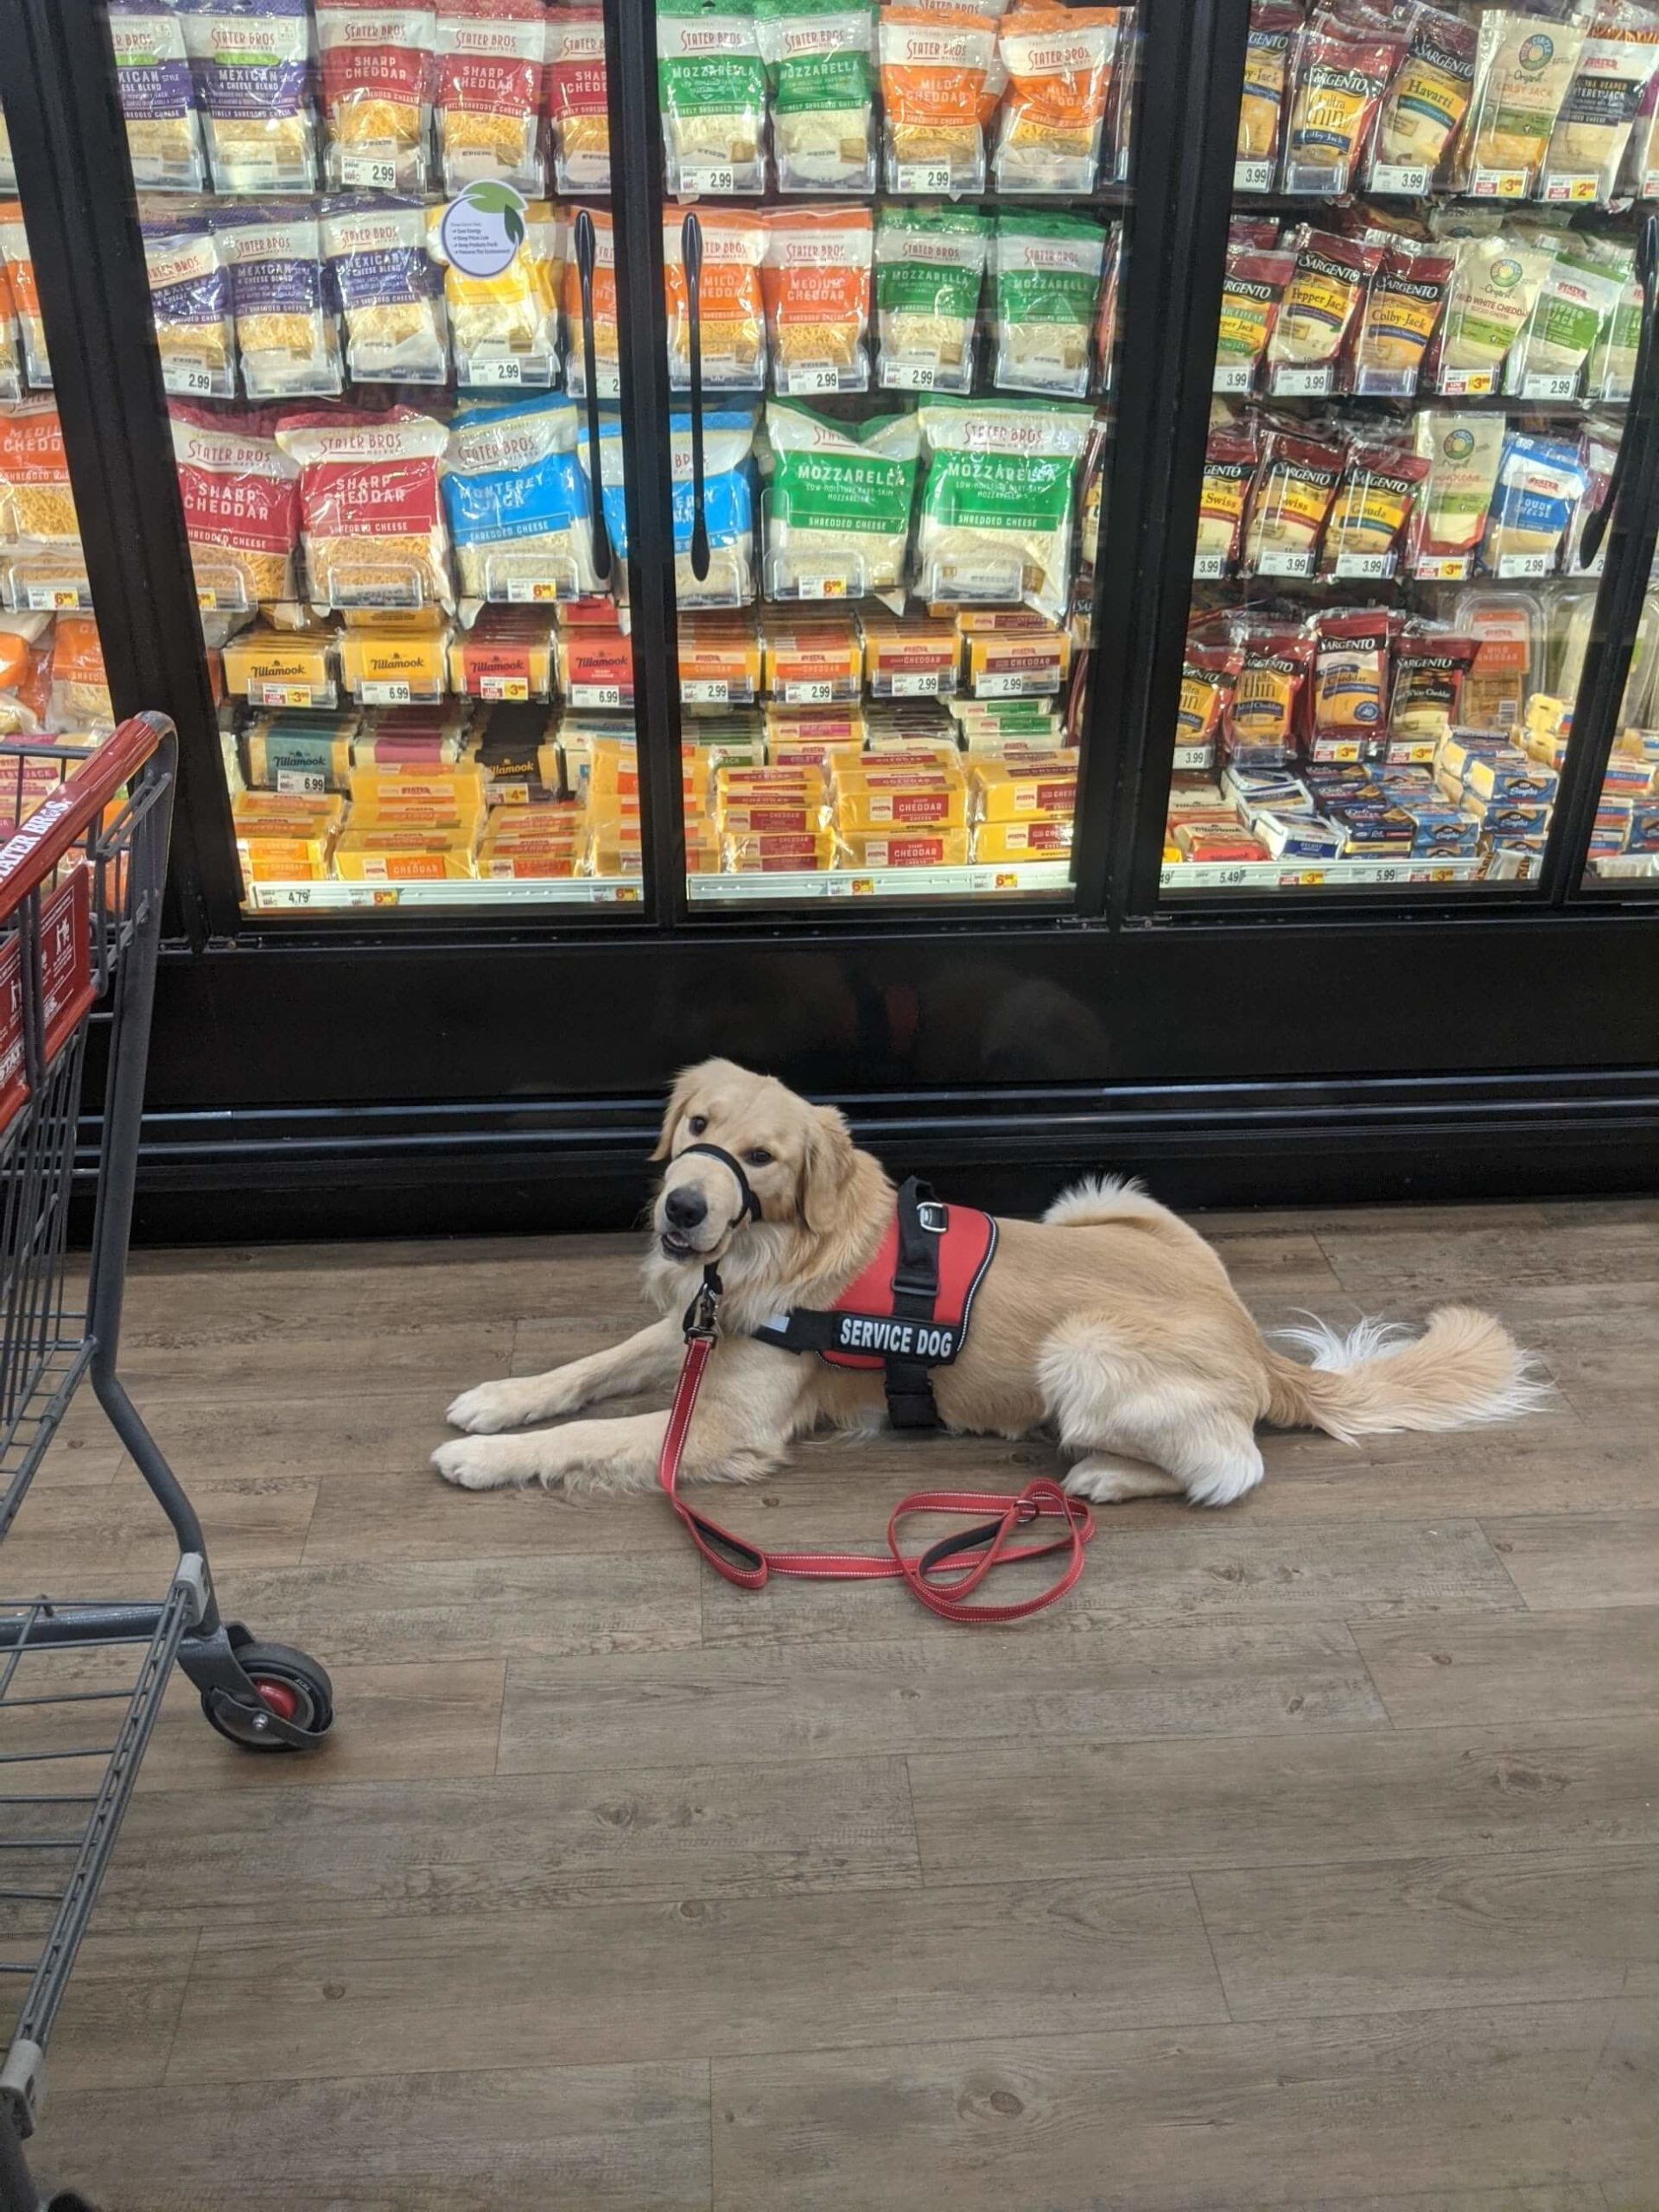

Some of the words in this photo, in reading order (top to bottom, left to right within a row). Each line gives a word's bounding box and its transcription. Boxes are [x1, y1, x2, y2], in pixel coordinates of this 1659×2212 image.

[345, 22, 379, 41] STATER
[381, 22, 407, 38] BROS
[456, 30, 489, 50] STATER
[492, 32, 517, 47] BROS
[563, 37, 597, 57] STATER
[681, 29, 715, 51] STATER
[785, 30, 818, 52] STATER
[906, 39, 940, 60] STATER
[354, 56, 396, 67] SHARP
[1028, 49, 1061, 71] STATER
[1415, 41, 1472, 78] SARGENTO
[219, 69, 277, 83] MEXICAN
[346, 67, 407, 80] CHEDDAR
[463, 66, 504, 79] SHARP
[780, 61, 861, 80] MOZZARELLA
[921, 79, 951, 91] MILD
[1408, 78, 1452, 109] Havarti
[372, 165, 394, 181] 2.99
[710, 172, 732, 188] 2.99
[927, 171, 949, 187] 2.99
[1246, 168, 1266, 183] 3.99
[1402, 173, 1422, 188] 3.99
[236, 241, 264, 258] STATER
[267, 237, 291, 251] BROS
[787, 243, 818, 262] STATER
[822, 242, 845, 257] BROS
[175, 256, 199, 273] BROS
[238, 265, 290, 277] MEXICAN
[1298, 253, 1360, 283] SARGENTO
[704, 275, 734, 286] MILD
[791, 279, 842, 290] MEDIUM
[893, 270, 969, 287] MOZZARELLA
[1377, 277, 1438, 299] SARGENTO
[787, 289, 845, 302] CHEDDAR
[1292, 289, 1325, 305] Pepper
[1326, 295, 1346, 313] Jack
[1372, 309, 1427, 330] Colby-Jack
[498, 364, 518, 379] 2.99
[912, 370, 932, 385] 2.99
[188, 373, 209, 389] 2.99
[817, 372, 837, 387] 2.99
[1227, 373, 1246, 386] 3.99
[1305, 376, 1325, 389] 3.99
[1550, 381, 1570, 395] 2.99
[3, 438, 62, 453] CHEDD
[321, 434, 363, 454] STATER
[369, 433, 402, 448] BROS
[503, 435, 535, 453] BROS
[188, 439, 232, 461] STATER
[238, 448, 270, 463] BROS
[798, 465, 904, 486] MOZZARELLA
[336, 474, 391, 492] SHARP
[199, 483, 257, 503] SHARP
[324, 487, 405, 505] CHEDDAR
[1206, 493, 1236, 509] Swiss
[184, 496, 268, 521] CHEDDAR
[1351, 503, 1387, 518] Gouda
[375, 520, 408, 532] CHEESE
[809, 517, 853, 530] SHREDDED
[855, 519, 887, 531] CHEESE
[958, 514, 1002, 526] SHREDDED
[1005, 516, 1038, 528] CHEESE
[470, 525, 514, 541] SHREDDED
[517, 522, 549, 534] CHEESE
[232, 537, 267, 549] CHEESE
[1199, 561, 1219, 573] 3.99
[1287, 559, 1306, 571] 3.99
[1363, 561, 1382, 573] 3.99
[1524, 558, 1544, 572] 2.99
[371, 658, 424, 671] Tillamook
[470, 660, 524, 674] Tillamook
[575, 655, 628, 669] Tillamook
[904, 656, 942, 664] CHEDDAR
[1010, 658, 1051, 667] CHEDDAR
[1396, 657, 1452, 668] SARGENTO
[251, 664, 305, 678] Tillamook
[708, 684, 727, 697] 2.99
[918, 677, 937, 690] 2.99
[1003, 677, 1021, 690] 2.99
[1243, 676, 1276, 699] thin
[390, 687, 408, 700] 6.99
[599, 690, 618, 703] 6.99
[811, 685, 830, 699] 2.99
[273, 755, 327, 767] Tillamook
[1185, 751, 1204, 763] 3.99
[304, 777, 324, 791] 6.99
[899, 803, 942, 812] CHEDDAR
[893, 848, 937, 858] CHEDDAR
[1219, 871, 1239, 883] 5.49
[1376, 869, 1395, 881] 5.99
[289, 892, 309, 905] 4.79
[840, 1318, 912, 1354] SERVICE
[916, 1328, 953, 1359] DOG
